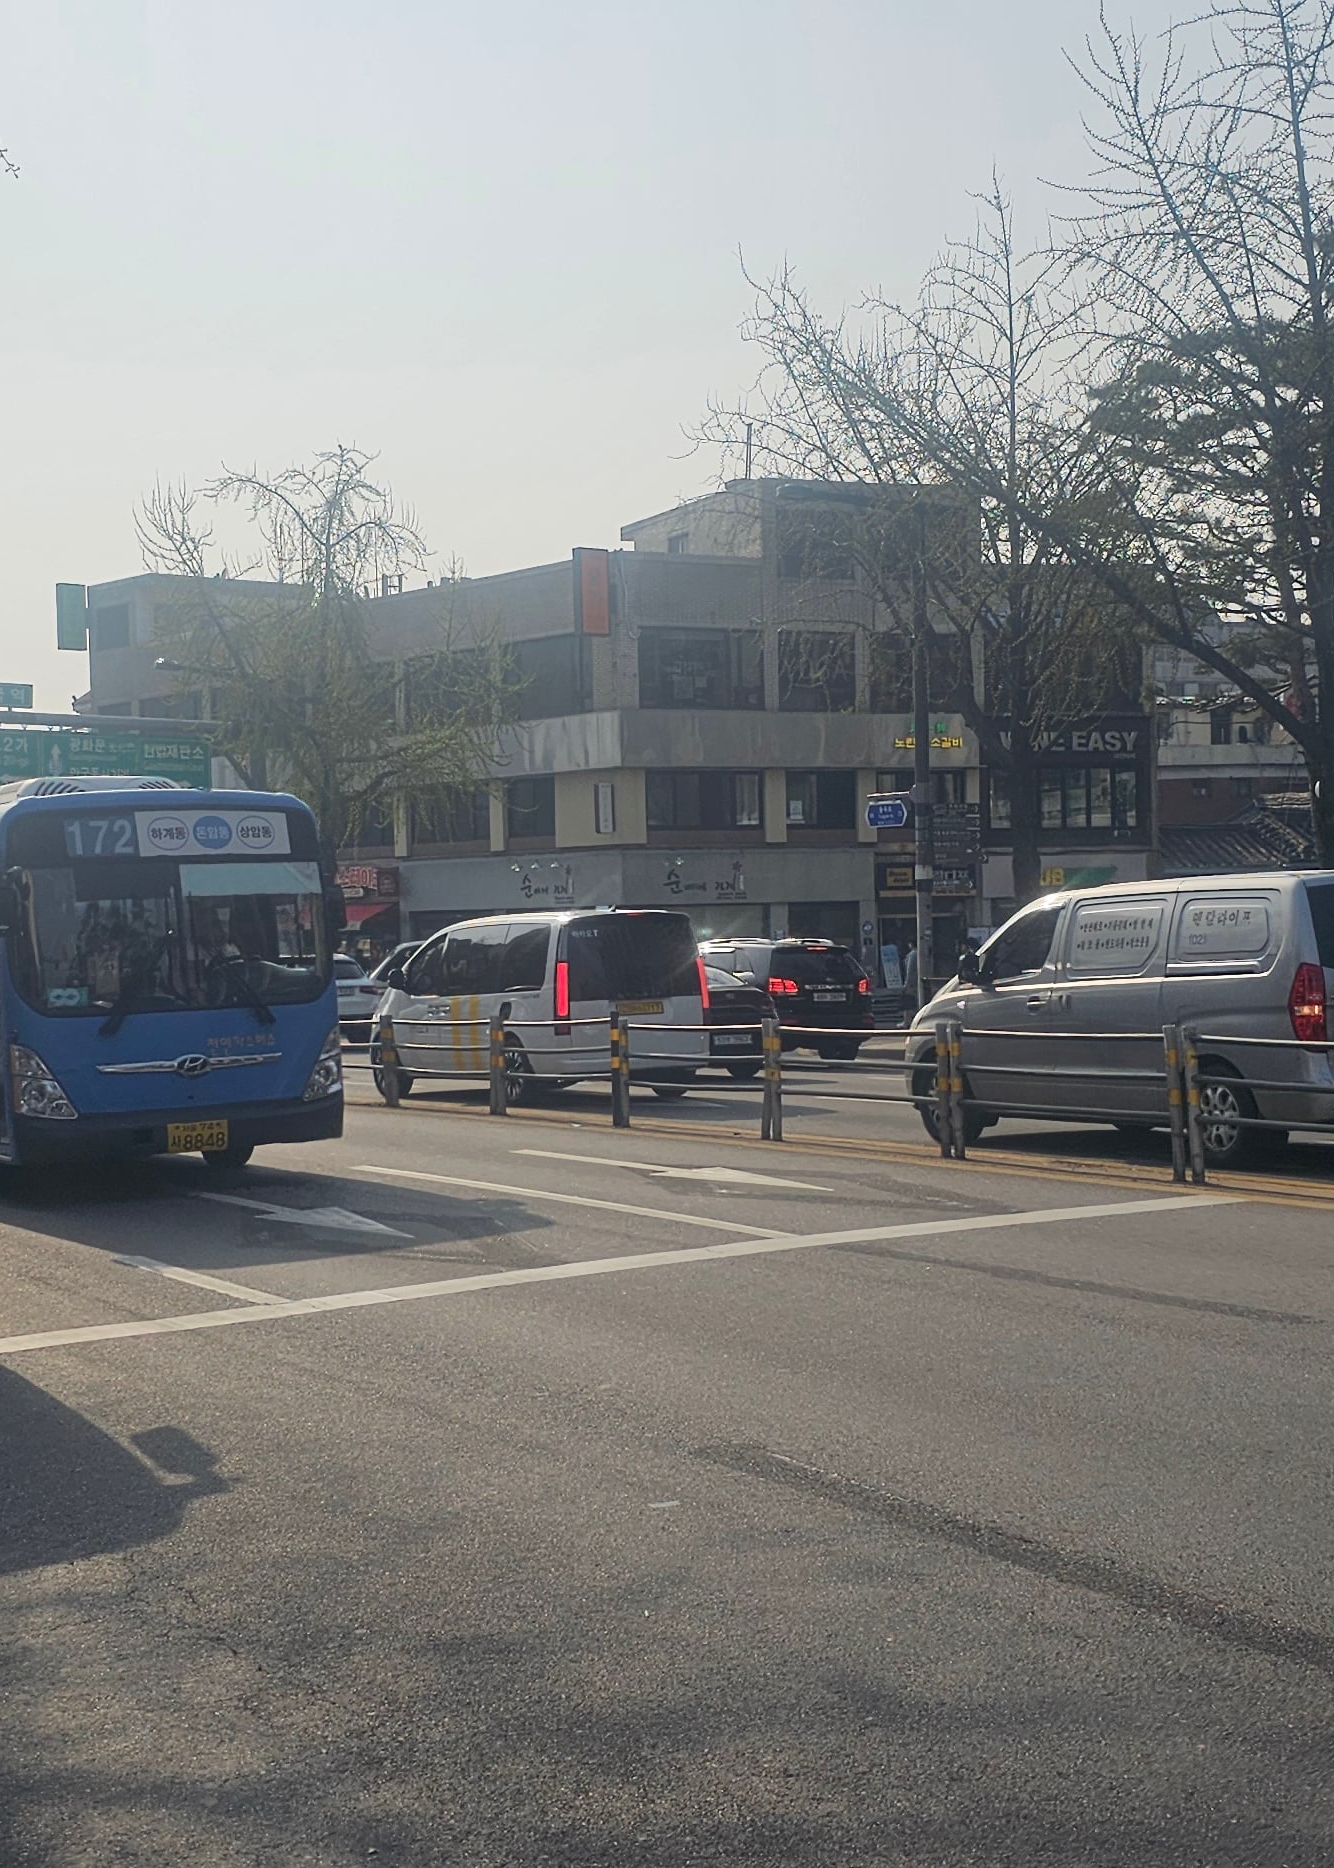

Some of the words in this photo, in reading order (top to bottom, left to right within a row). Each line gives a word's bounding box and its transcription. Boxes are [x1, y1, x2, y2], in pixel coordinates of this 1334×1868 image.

[69, 738, 105, 753] 광화문
[1072, 731, 1138, 751] EASY
[66, 818, 135, 856] 172
[150, 827, 187, 841] 하계동
[195, 826, 230, 841] 돈암동
[239, 826, 273, 840] 상암동
[170, 1131, 226, 1151] 사8848
